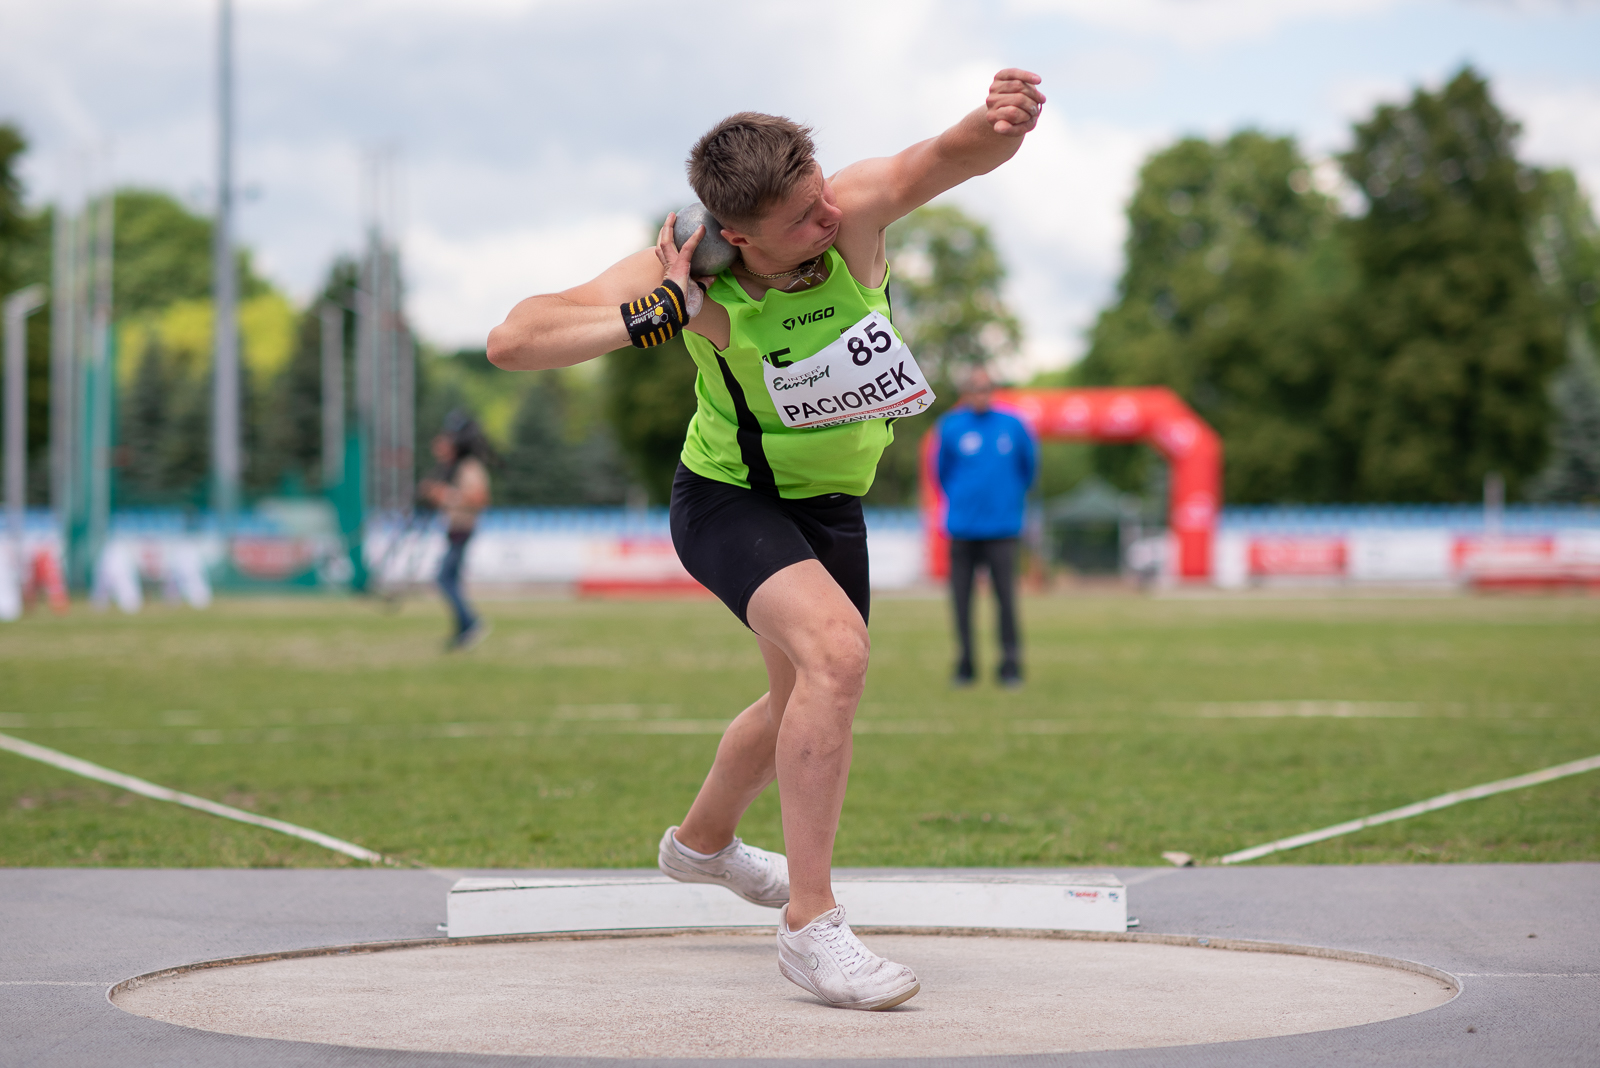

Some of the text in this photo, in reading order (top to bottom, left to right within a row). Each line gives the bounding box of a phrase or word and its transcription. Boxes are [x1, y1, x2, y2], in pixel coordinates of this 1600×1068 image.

[847, 321, 892, 366] 85
[773, 365, 830, 391] Europol
[783, 361, 917, 421] PACIOREK
[806, 415, 877, 429] ARSZAWA
[879, 406, 912, 419] 2022
